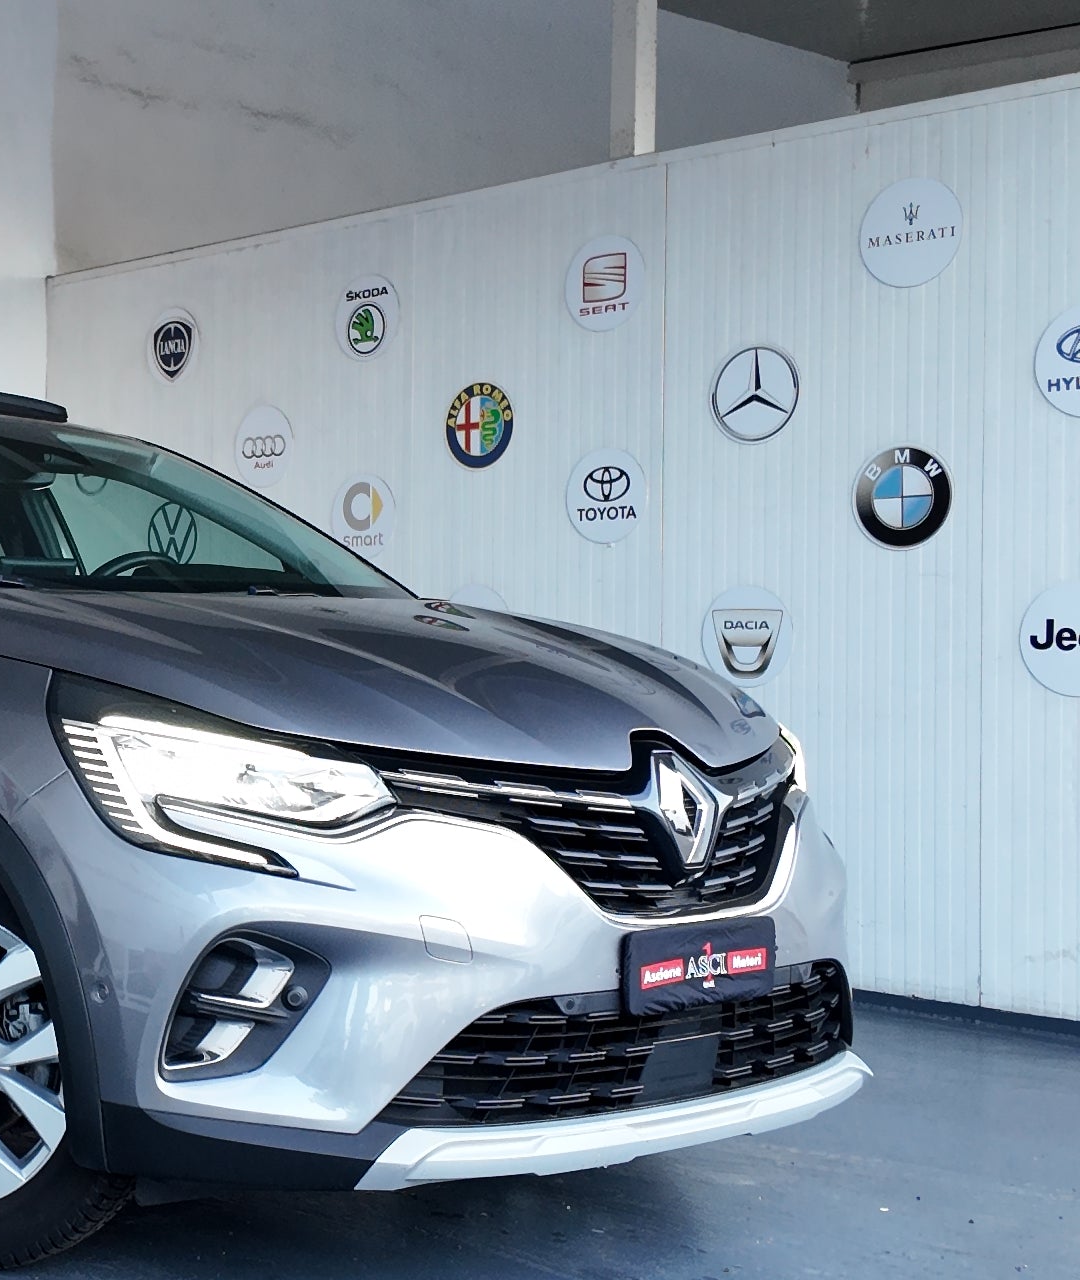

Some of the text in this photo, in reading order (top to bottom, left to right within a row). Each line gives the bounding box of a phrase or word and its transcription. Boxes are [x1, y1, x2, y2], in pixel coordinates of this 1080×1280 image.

[868, 226, 956, 248] MASERATI
[345, 286, 388, 302] ŠKODA
[579, 302, 629, 317] SEAT
[160, 339, 186, 355] LANCIA
[447, 384, 512, 428] ALFA ROMEO
[254, 460, 273, 469] Audi
[864, 449, 942, 481] BMW
[577, 505, 637, 521] TOYOTA
[342, 531, 384, 548] smart
[724, 619, 770, 631] DACIA
[1030, 619, 1080, 651] Je
[685, 953, 727, 979] ASCI
